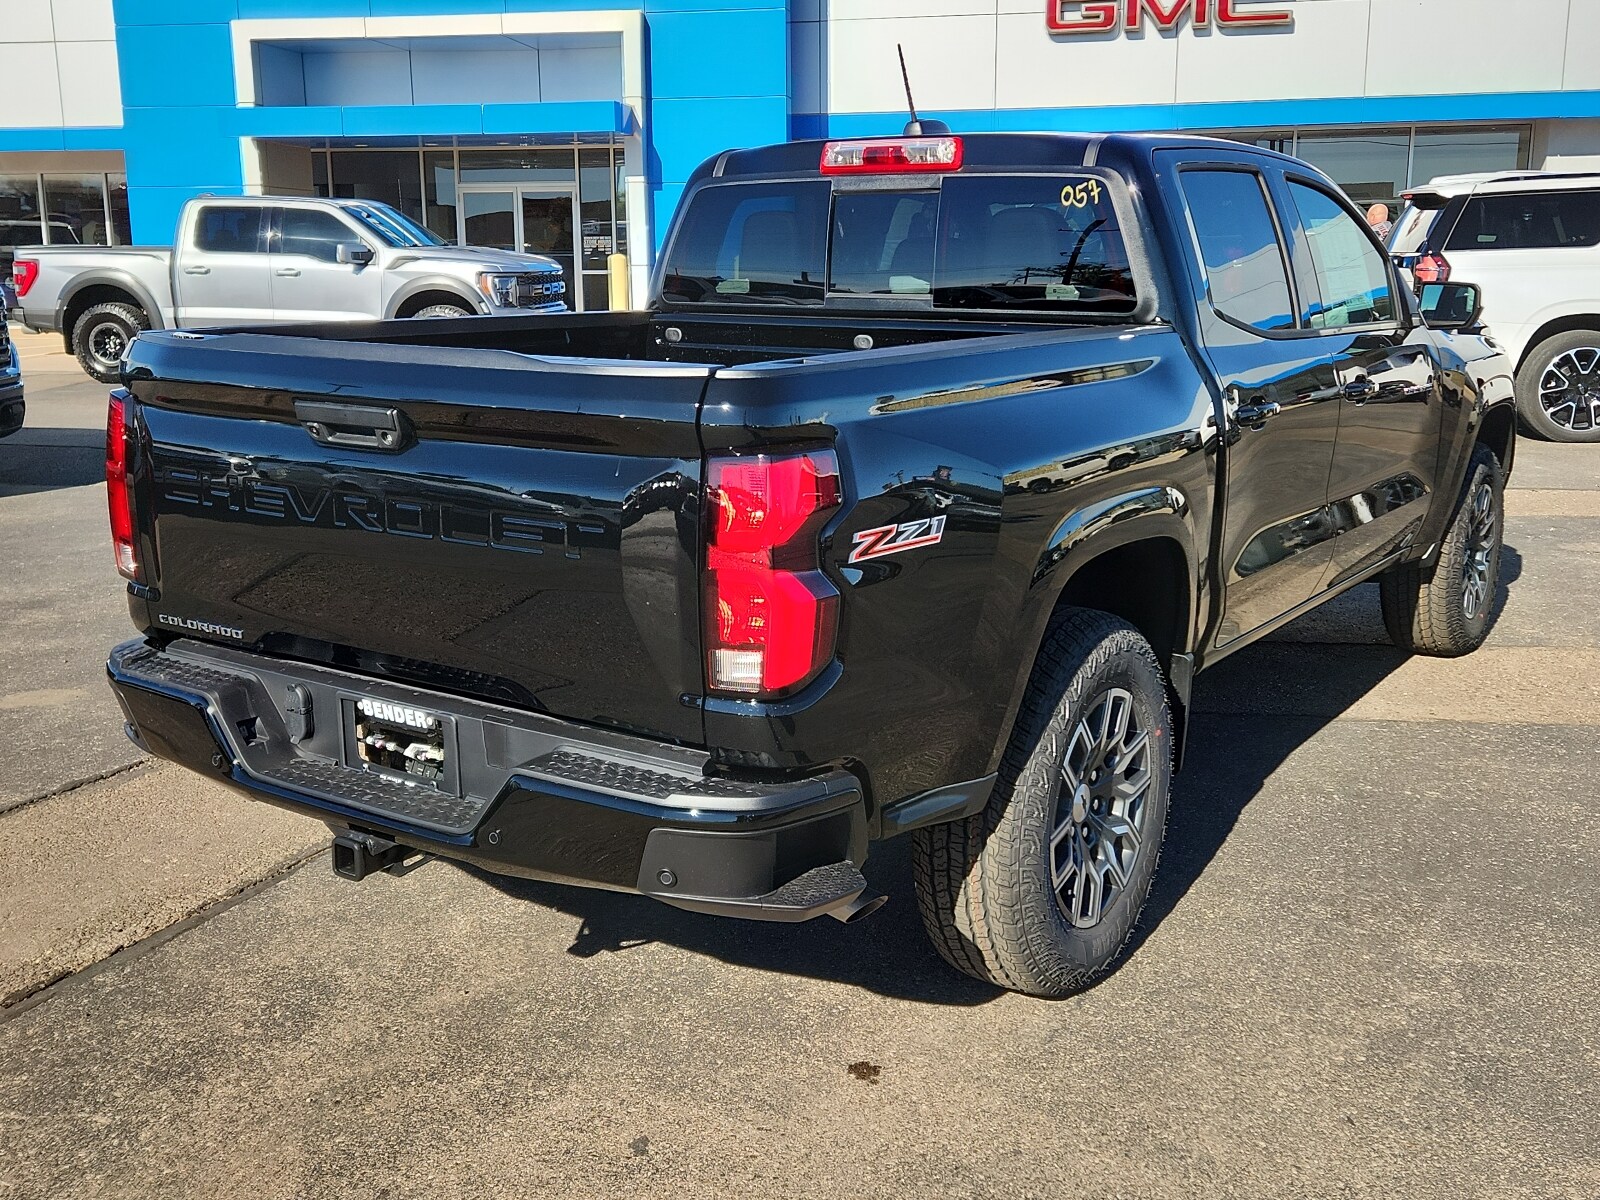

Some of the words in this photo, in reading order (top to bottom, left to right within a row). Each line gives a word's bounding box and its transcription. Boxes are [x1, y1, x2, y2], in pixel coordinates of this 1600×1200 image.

[1061, 179, 1102, 208] 057
[163, 466, 605, 559] CHEVROLET
[848, 514, 947, 564] Z71
[159, 613, 244, 639] COLORADO
[362, 698, 428, 729] BENDER
